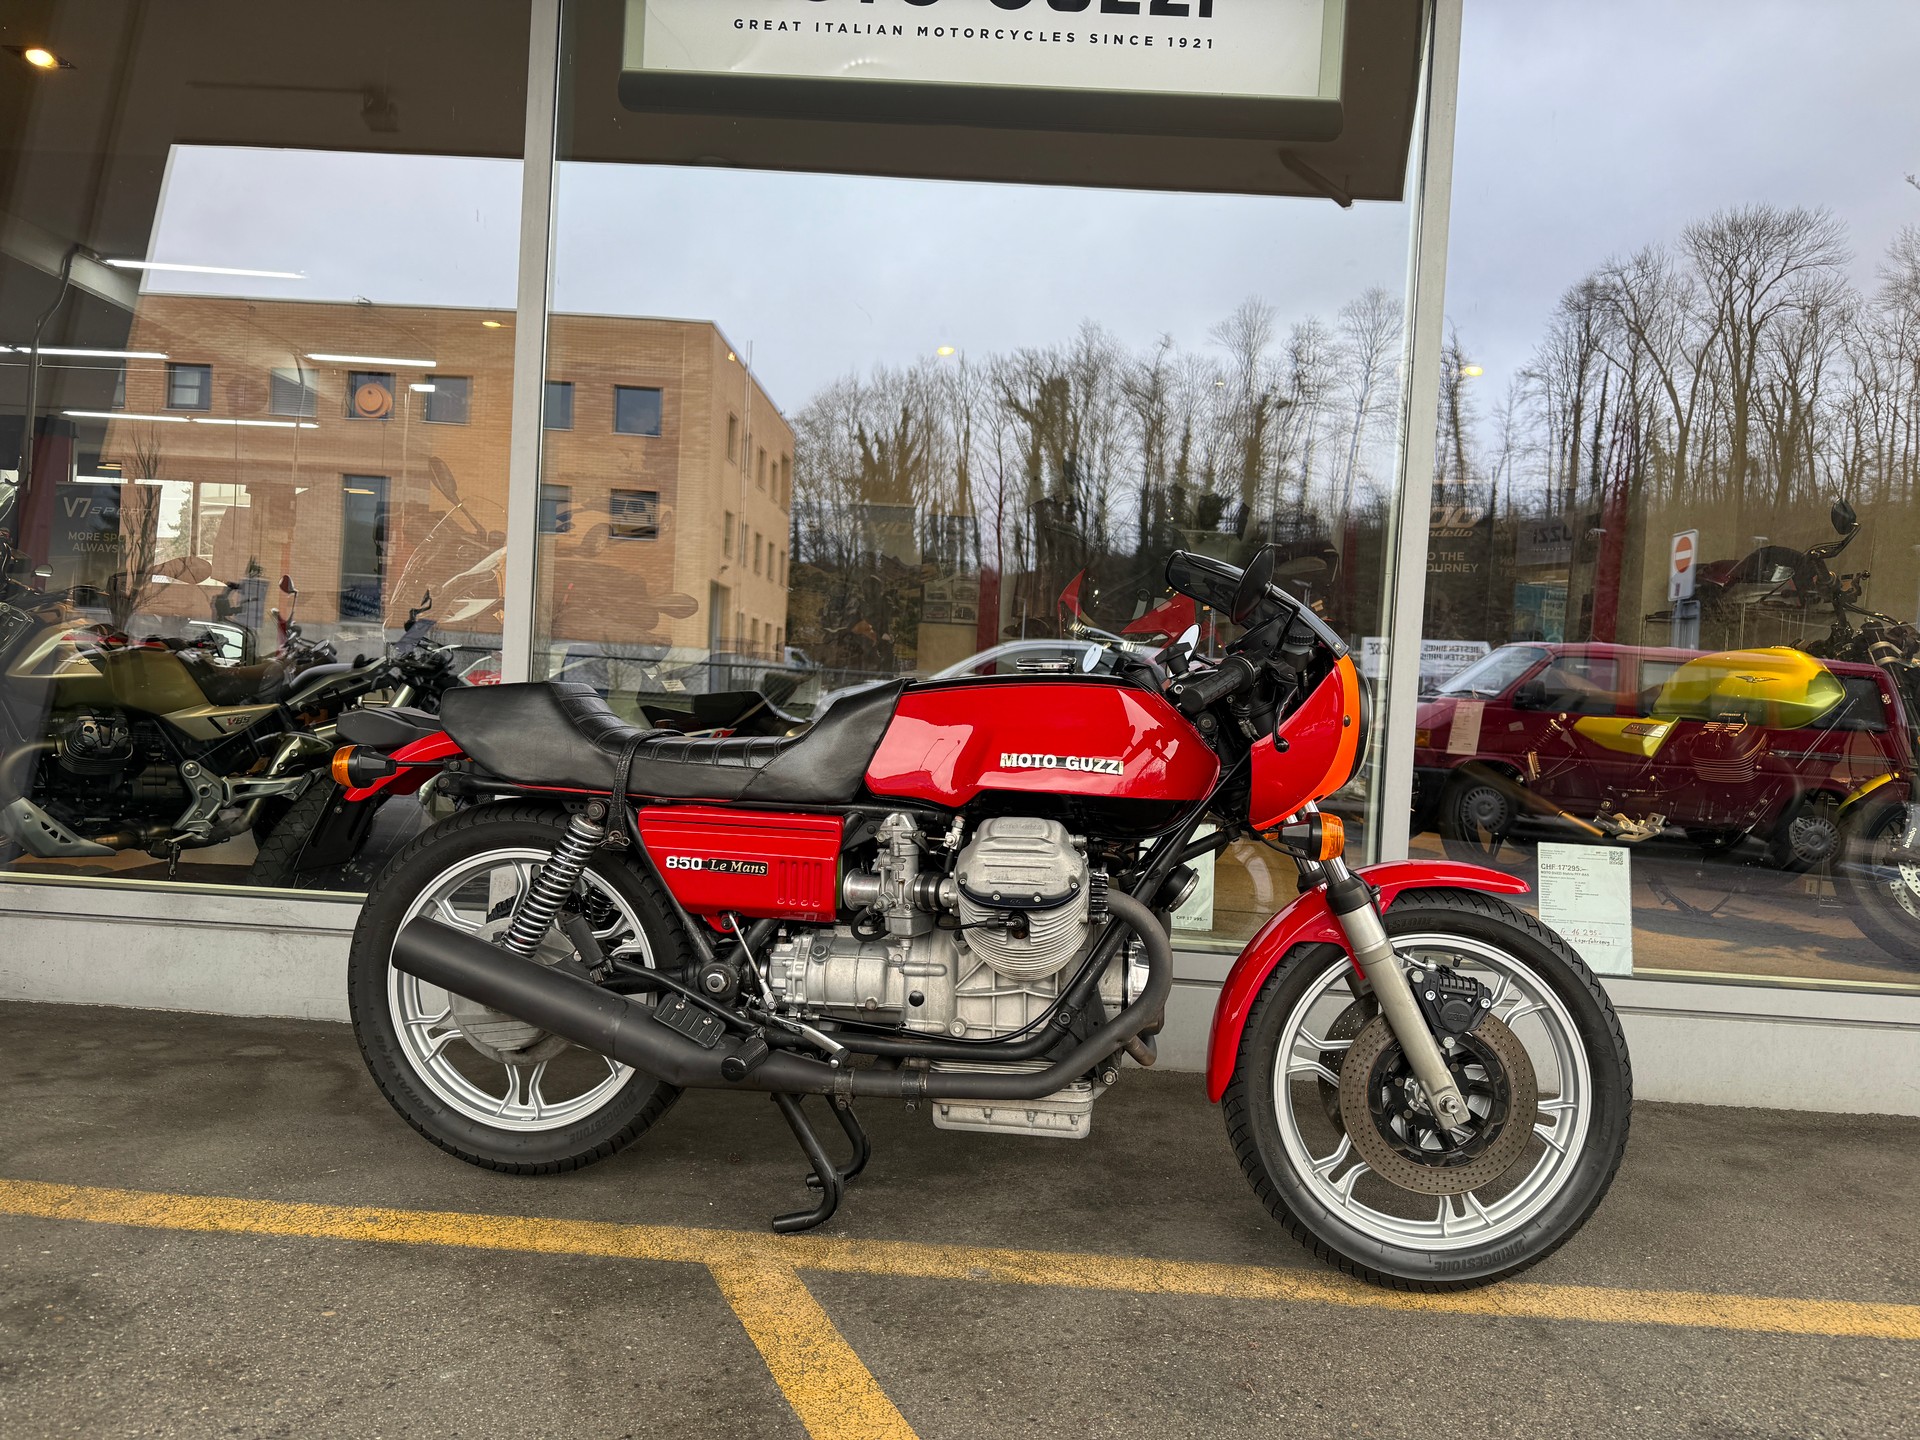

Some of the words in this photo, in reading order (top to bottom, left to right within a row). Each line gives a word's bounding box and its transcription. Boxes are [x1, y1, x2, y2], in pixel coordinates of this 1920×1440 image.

[734, 19, 801, 31] GREAT
[815, 22, 902, 35] ITALIAN
[917, 26, 1075, 43] MOTORCYCLES
[1089, 34, 1153, 46] SINCE
[1168, 37, 1212, 49] 1921
[63, 497, 91, 518] V7
[68, 531, 100, 541] MORE
[72, 542, 119, 553] ALWAYS
[1440, 552, 1465, 561] THE
[1426, 563, 1479, 573] OURNEY
[1000, 753, 1057, 768] MOTO
[1065, 756, 1124, 776] GUZZI
[1903, 827, 1917, 849] brembo
[666, 856, 702, 871] 850
[710, 860, 727, 871] Le
[730, 861, 767, 874] Mans
